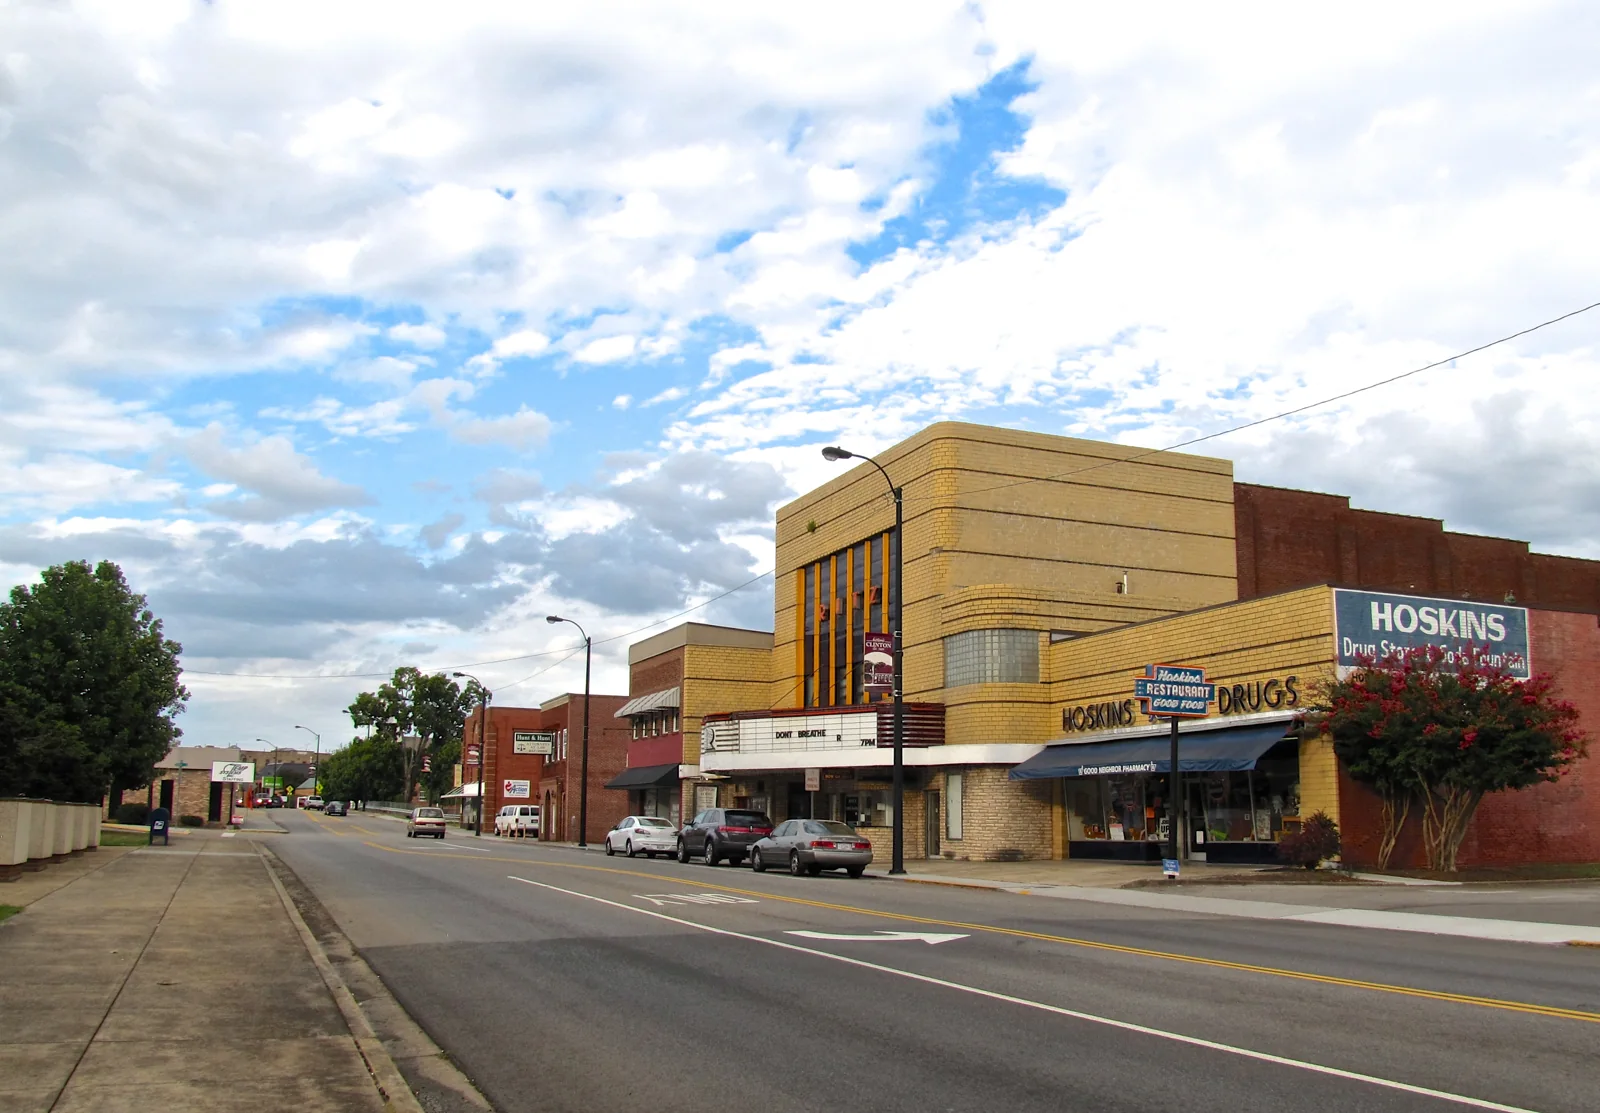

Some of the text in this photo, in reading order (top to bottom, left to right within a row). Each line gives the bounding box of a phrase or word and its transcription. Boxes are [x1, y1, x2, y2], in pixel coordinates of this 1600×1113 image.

[1370, 601, 1506, 642] HOSKINS
[865, 641, 892, 649] CLINTON
[1343, 637, 1376, 663] Drug
[1158, 669, 1201, 684] Hoskins
[1146, 682, 1210, 698] RESTAURANT
[1218, 675, 1298, 714] DRUGS
[1153, 697, 1205, 710] GOOD FOOD
[1062, 699, 1135, 732] HOSKINS
[775, 729, 826, 739] DONT BREATHE
[836, 734, 842, 742] R
[860, 738, 876, 747] 7PM
[1083, 764, 1150, 775] GOOD NEIGHBOR PHARMACY
